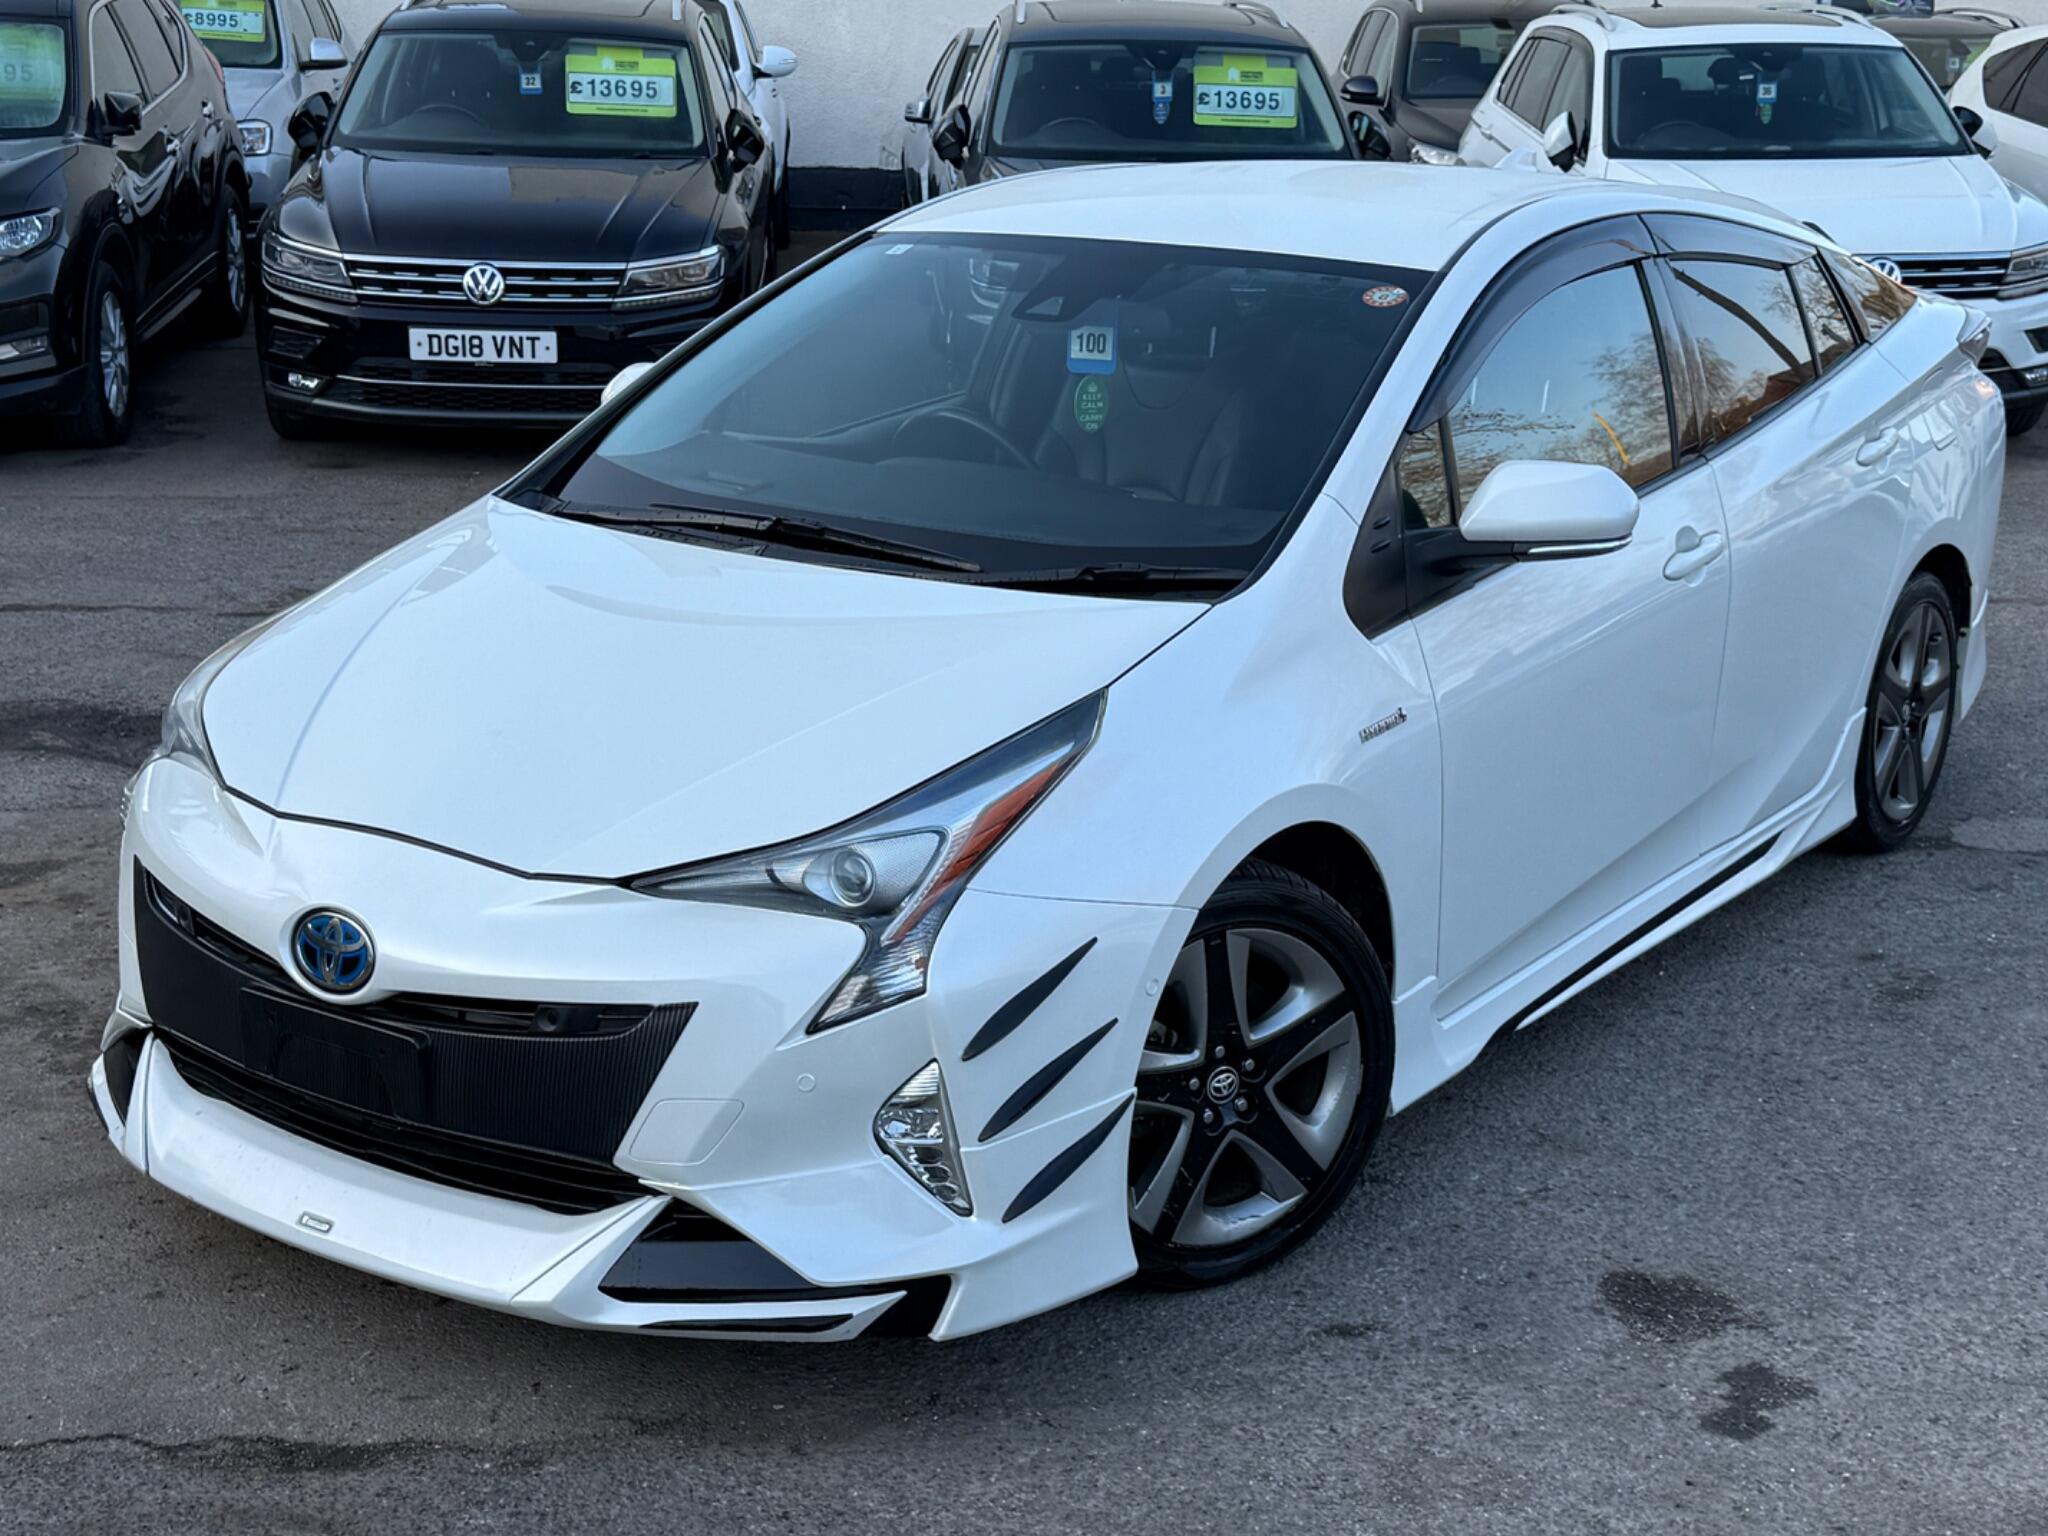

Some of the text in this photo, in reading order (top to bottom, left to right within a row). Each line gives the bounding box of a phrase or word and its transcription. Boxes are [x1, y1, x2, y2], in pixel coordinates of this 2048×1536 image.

[0, 63, 34, 82] 95
[569, 78, 658, 99] £13695
[1198, 90, 1280, 110] £13695
[427, 333, 541, 359] DG18 VNT
[1076, 332, 1107, 354] 100
